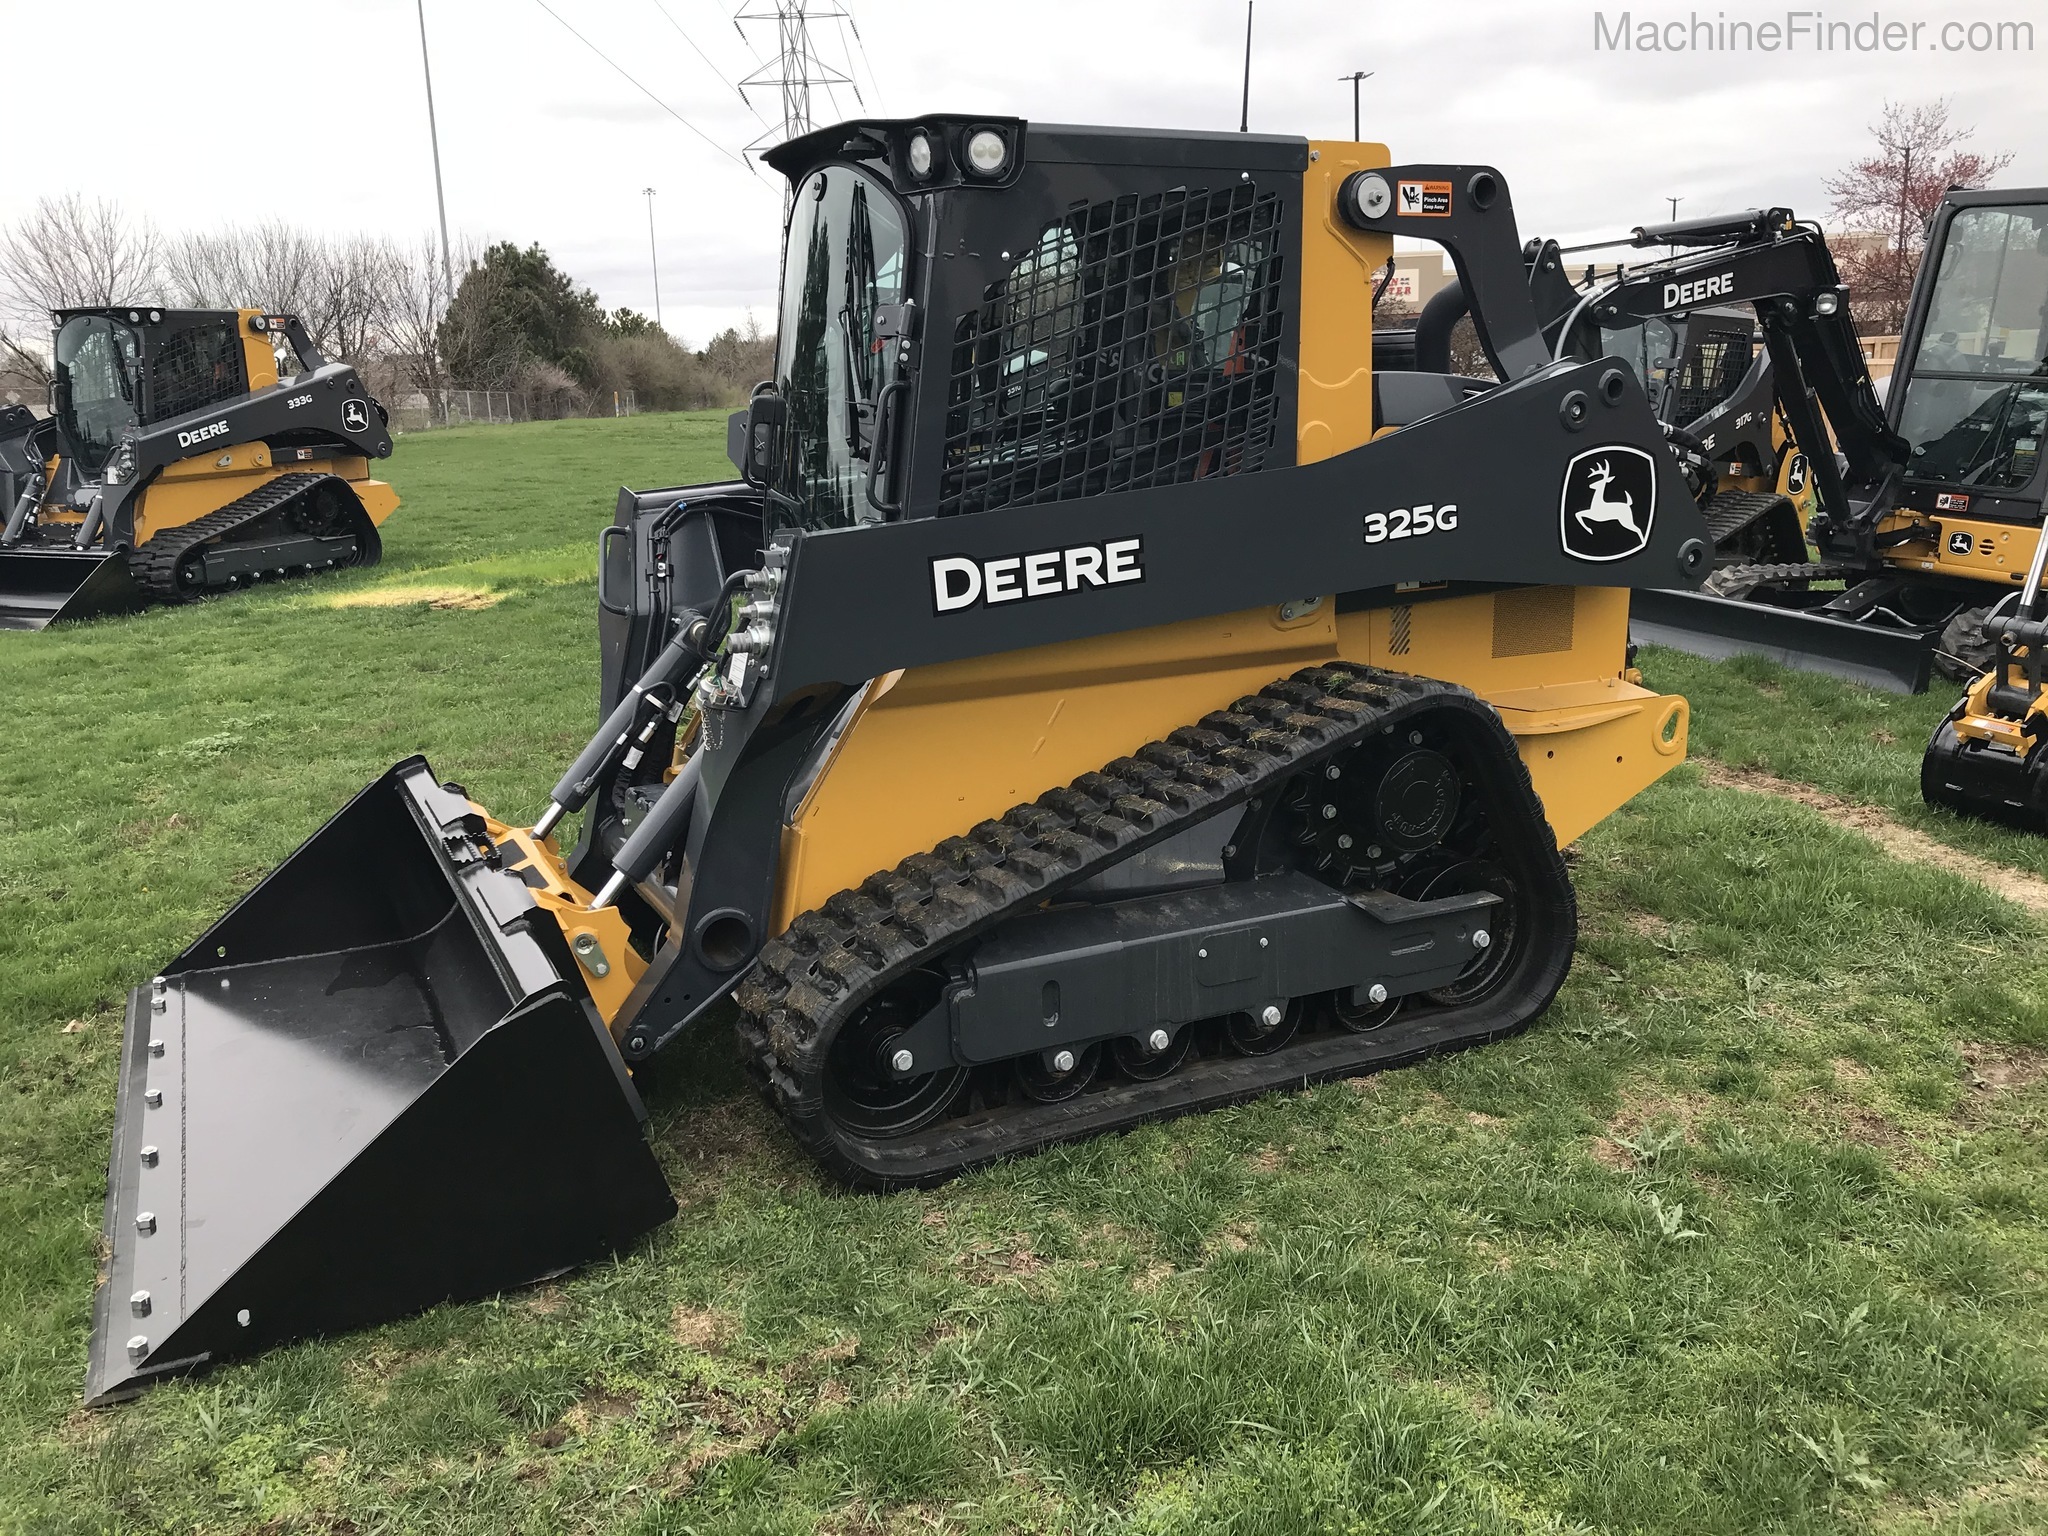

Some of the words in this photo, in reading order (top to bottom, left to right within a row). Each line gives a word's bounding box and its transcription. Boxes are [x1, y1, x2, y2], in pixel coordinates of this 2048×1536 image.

[1664, 272, 1734, 309] DEERE
[287, 394, 313, 409] 333G
[177, 420, 230, 448] DEERE
[1735, 412, 1752, 429] 317G
[1364, 504, 1458, 543] 325G
[932, 538, 1142, 612] DEERE
